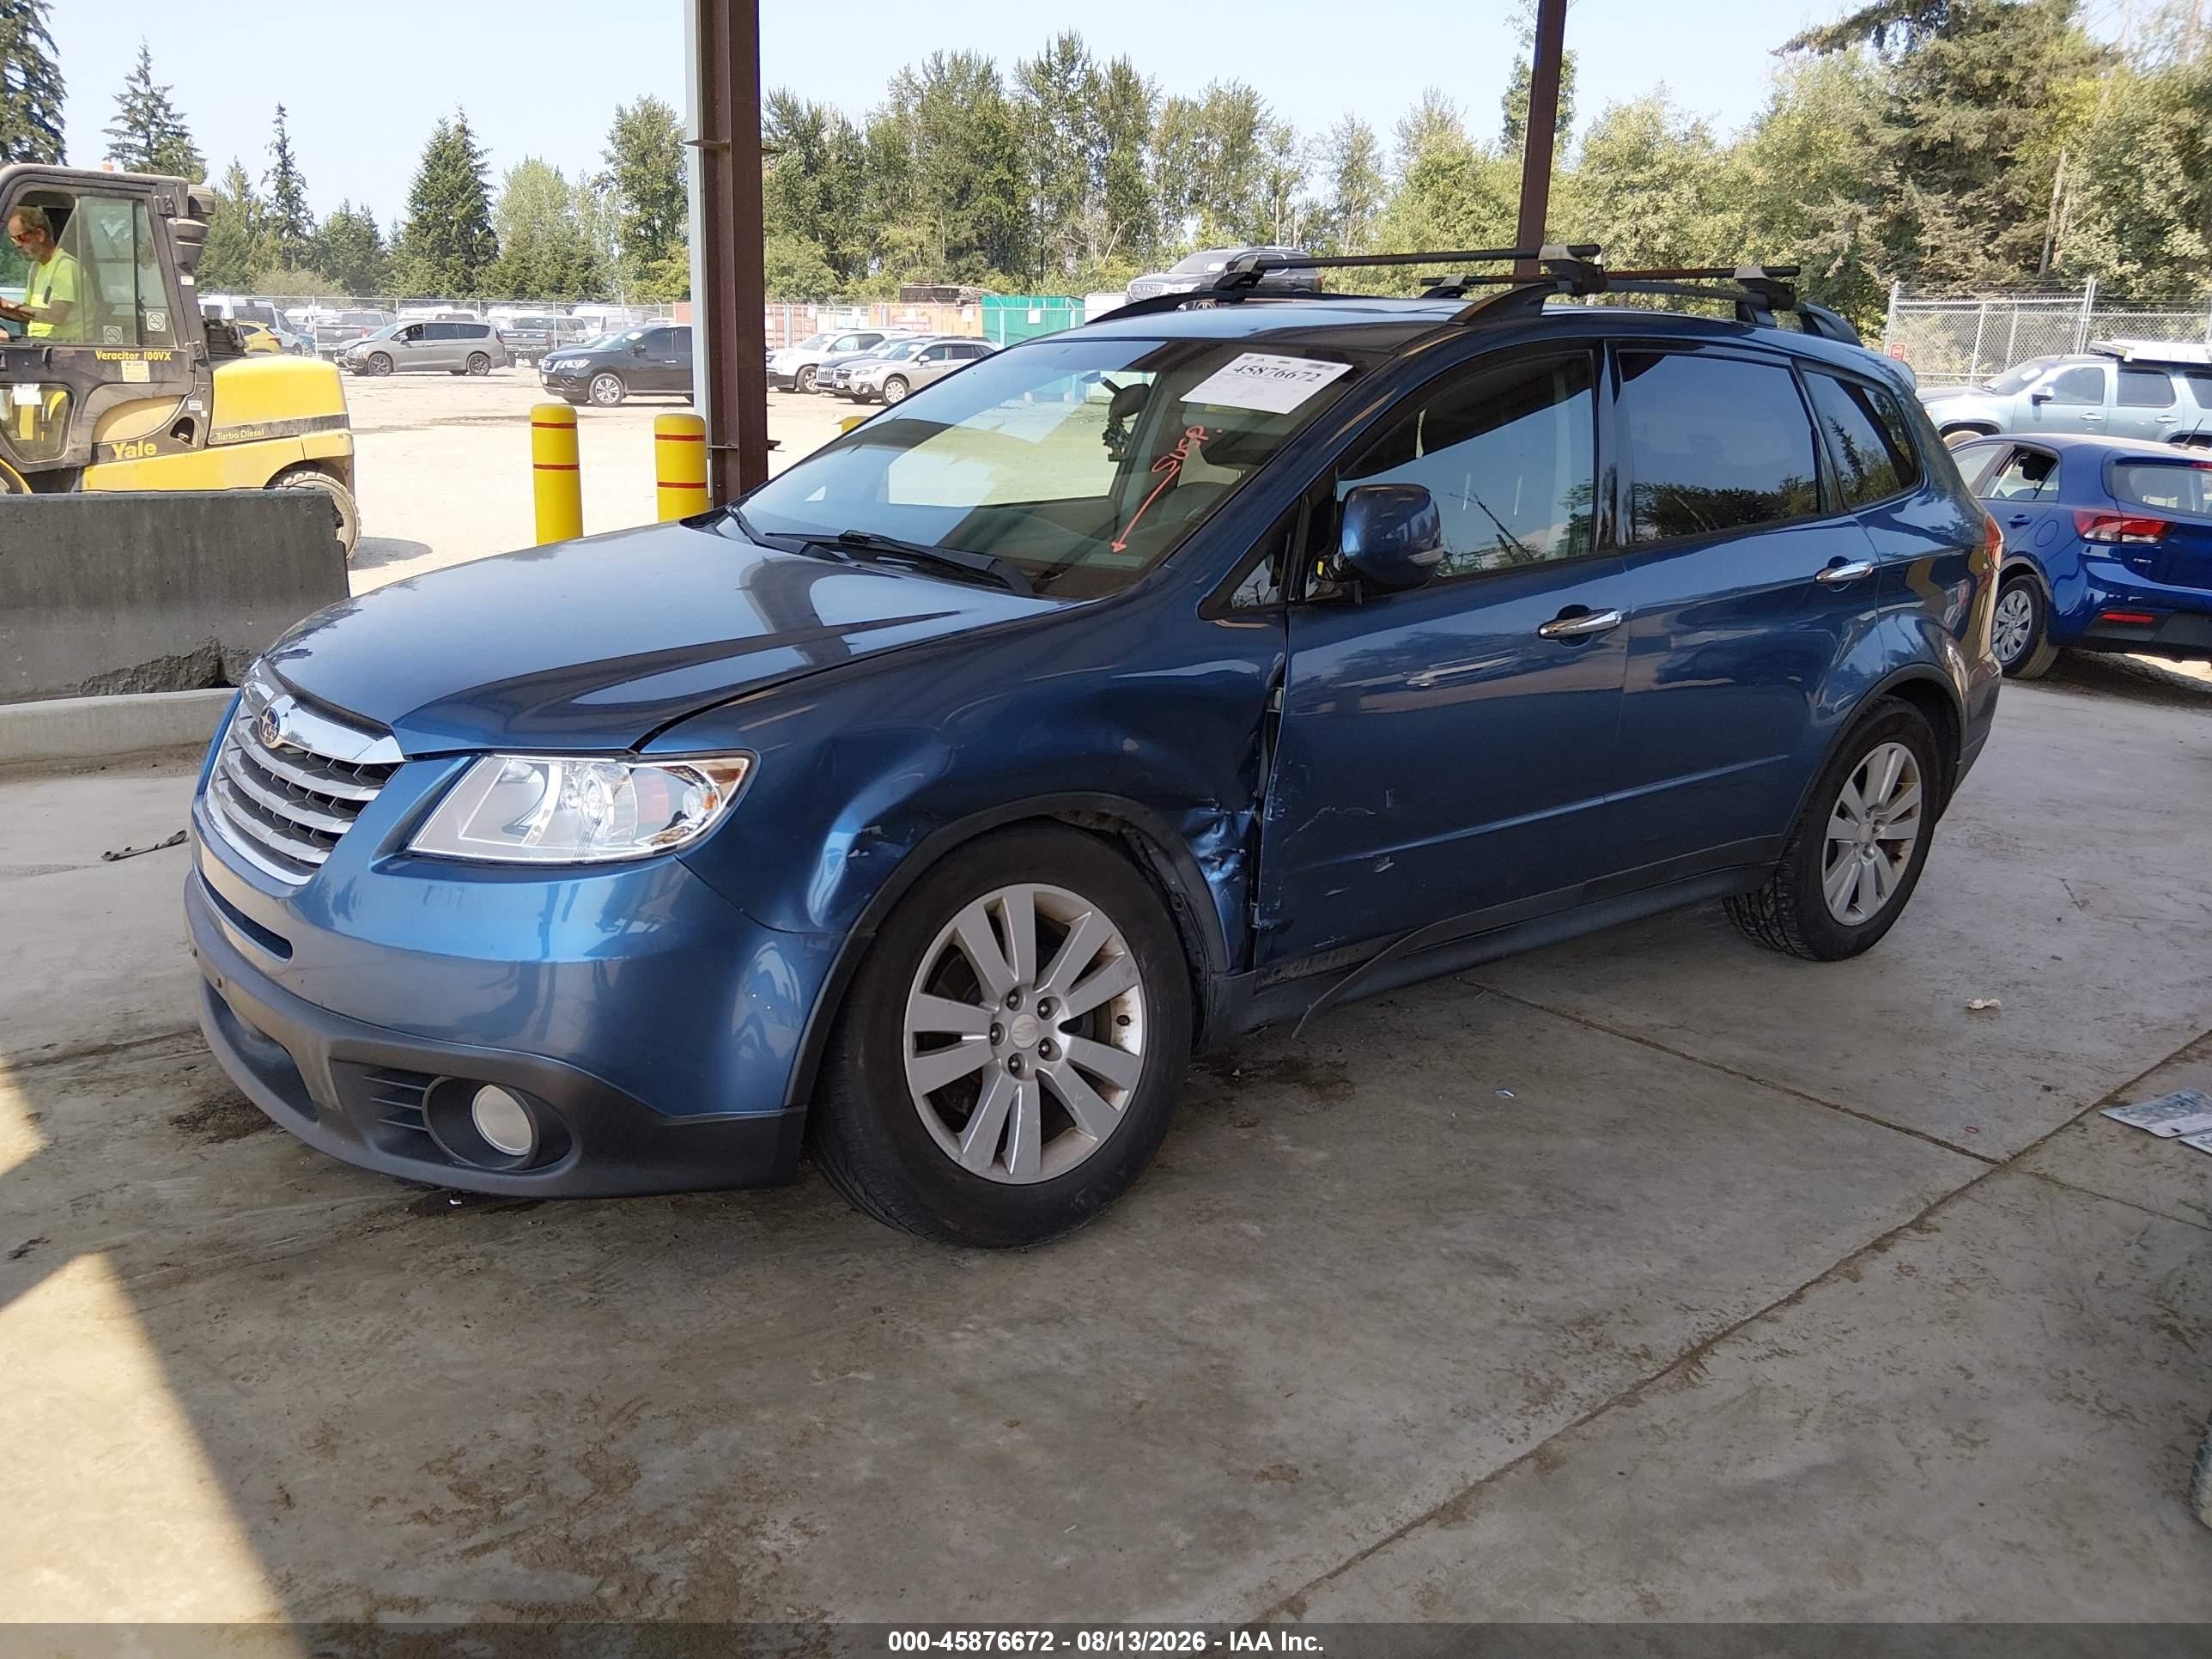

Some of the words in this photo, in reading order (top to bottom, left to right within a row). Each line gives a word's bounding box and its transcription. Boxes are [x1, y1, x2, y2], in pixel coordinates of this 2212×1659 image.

[95, 350, 140, 361] Veracitor
[143, 351, 172, 361] 100VX
[1232, 364, 1322, 383] 45876672
[216, 431, 240, 441] Turbo
[240, 428, 265, 439] Diesel
[111, 440, 157, 460] Yale
